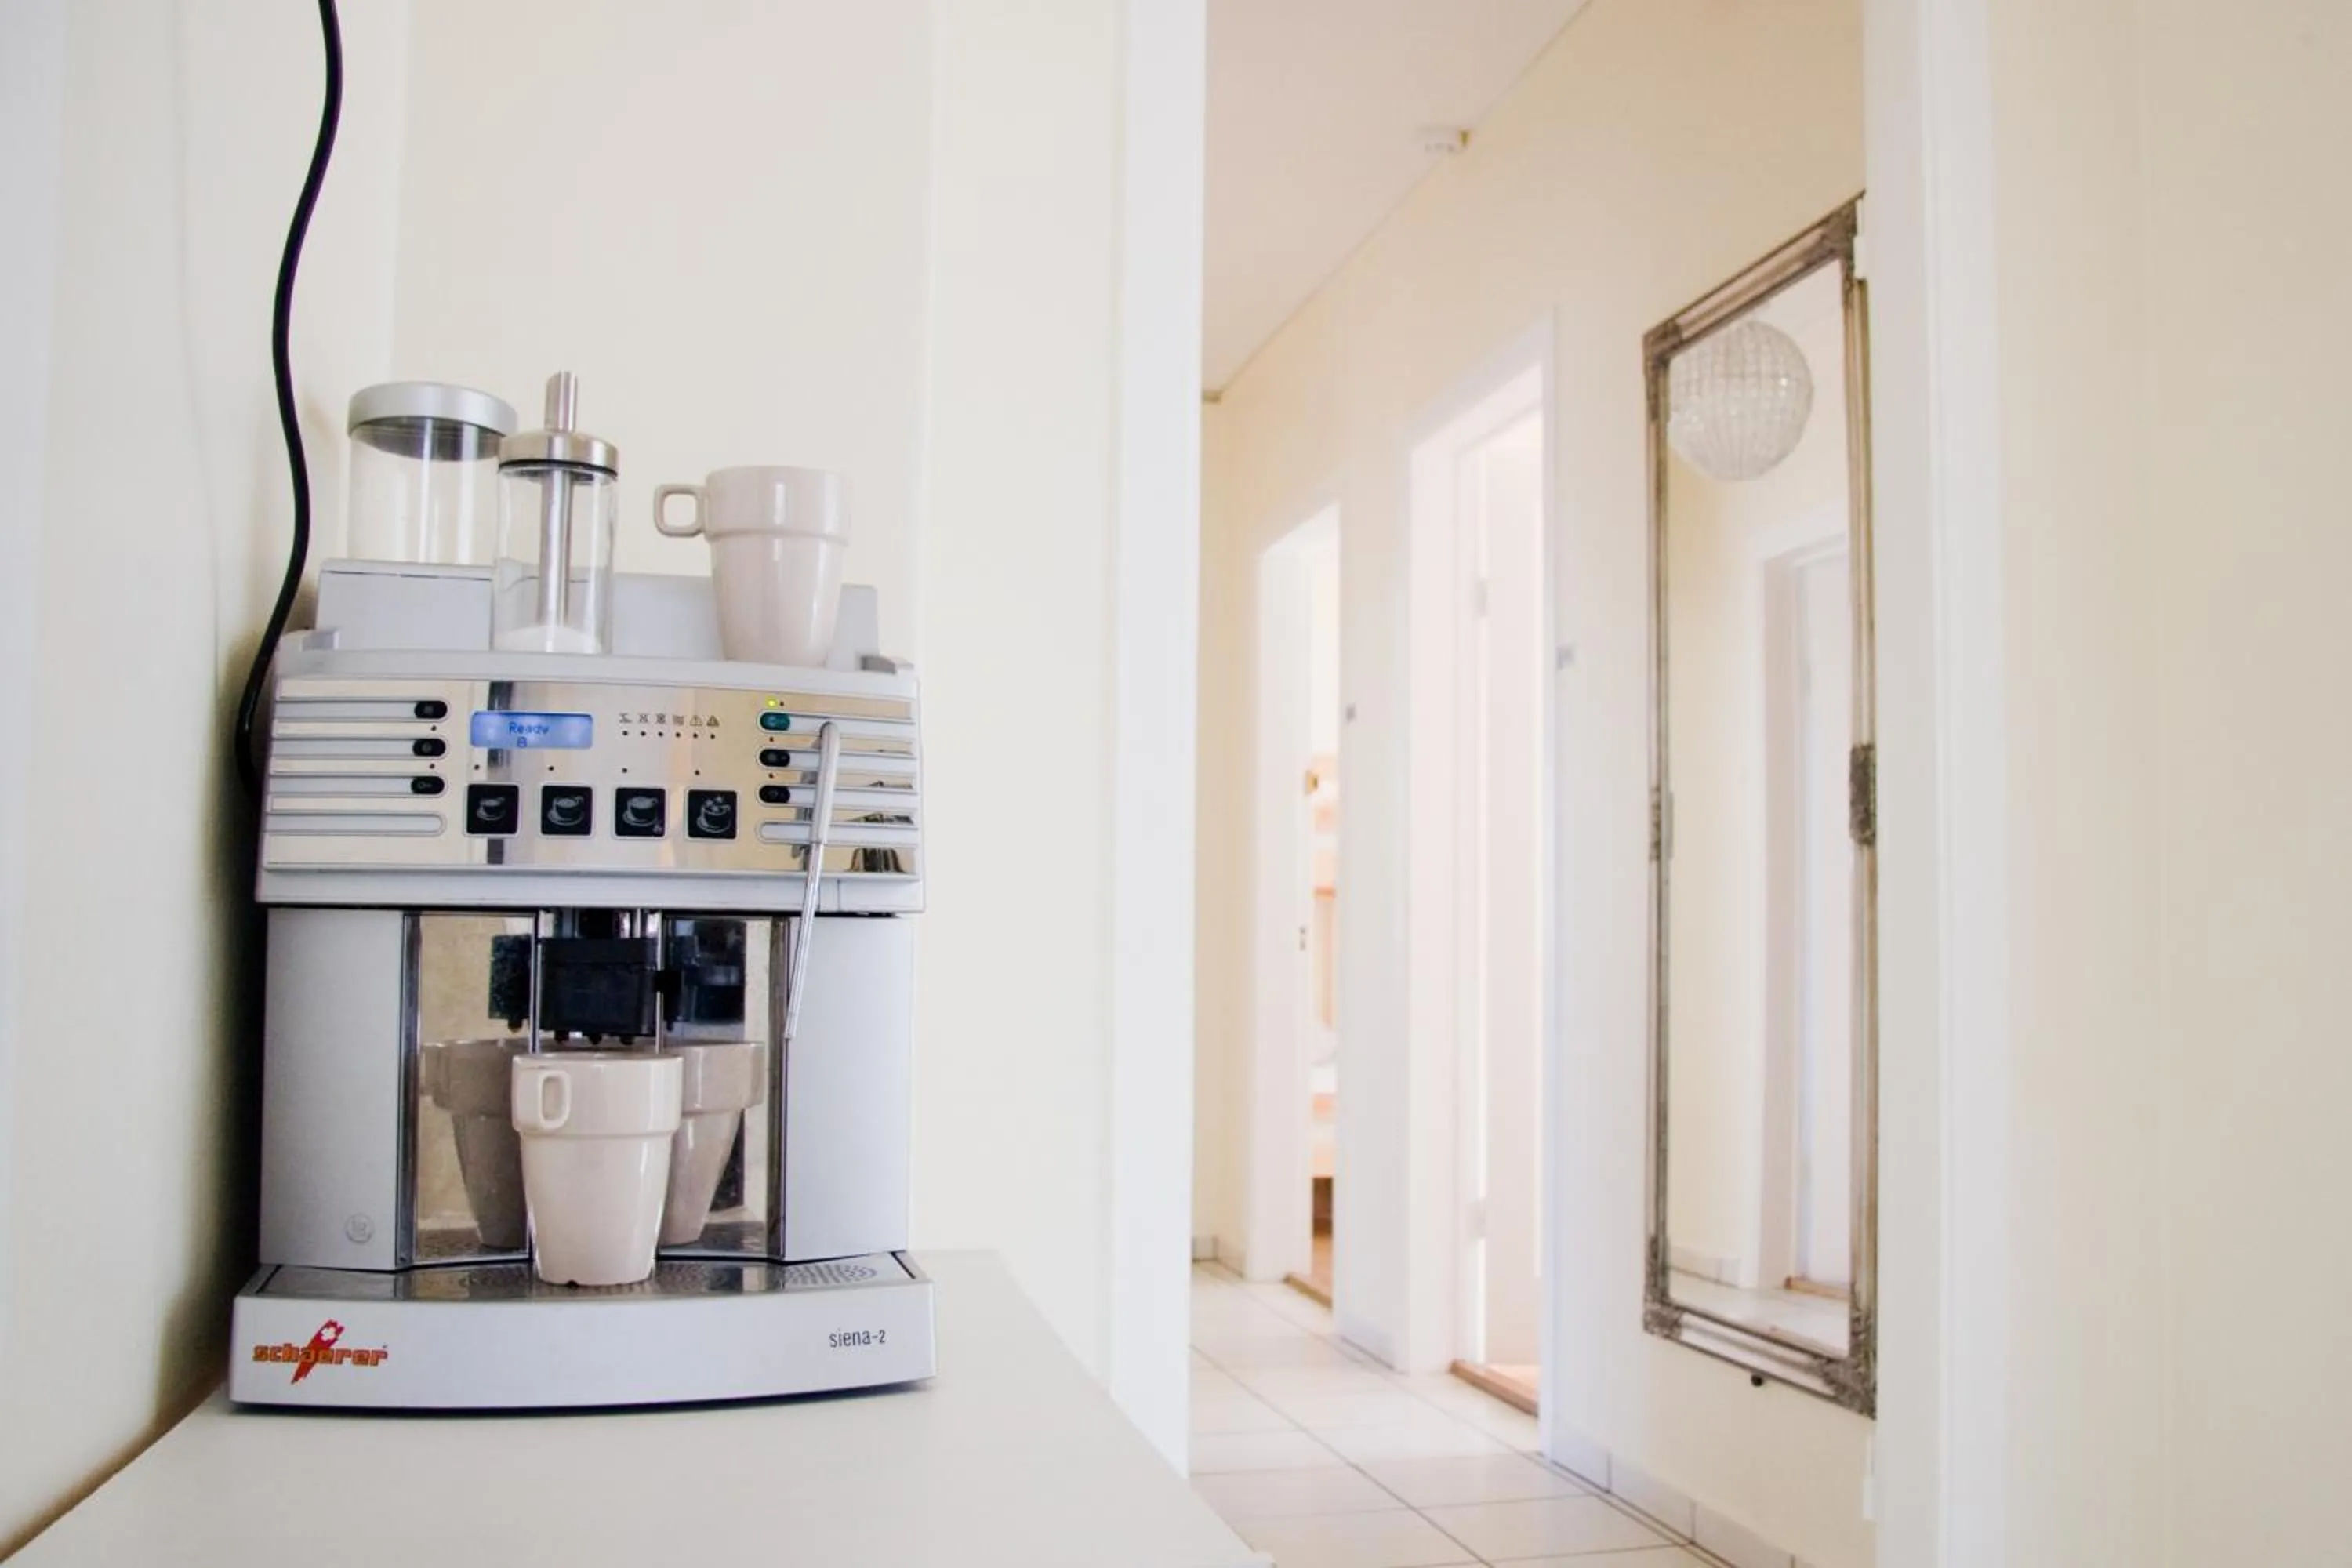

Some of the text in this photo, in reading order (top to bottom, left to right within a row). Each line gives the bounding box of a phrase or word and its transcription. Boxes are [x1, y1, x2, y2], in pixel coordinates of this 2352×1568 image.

[509, 720, 550, 735] Ready
[829, 1327, 886, 1348] siena-2
[252, 1343, 388, 1366] schaerer
